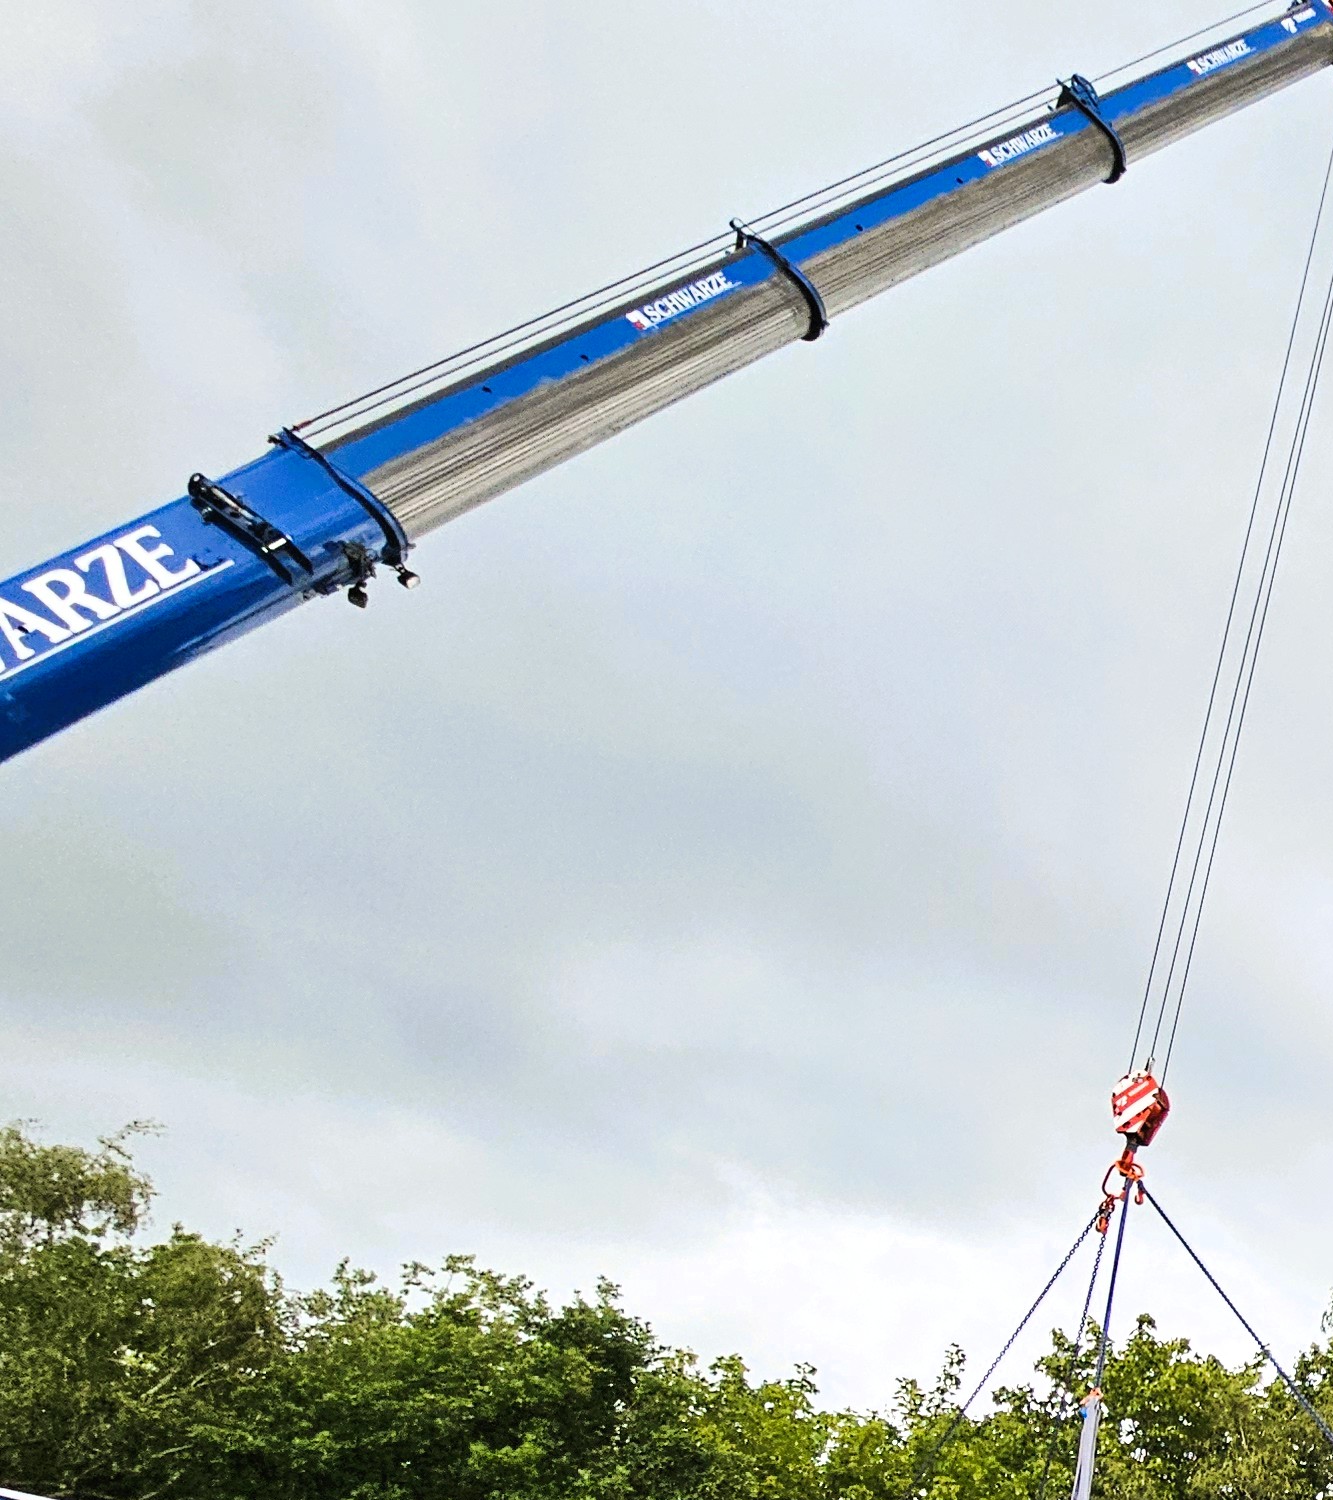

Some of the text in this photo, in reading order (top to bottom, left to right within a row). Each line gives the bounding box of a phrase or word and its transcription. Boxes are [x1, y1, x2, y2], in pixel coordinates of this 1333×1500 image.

[994, 123, 1057, 161] SCHWARZE
[643, 269, 734, 323] SCHWARZE
[0, 525, 201, 672] ARZE
